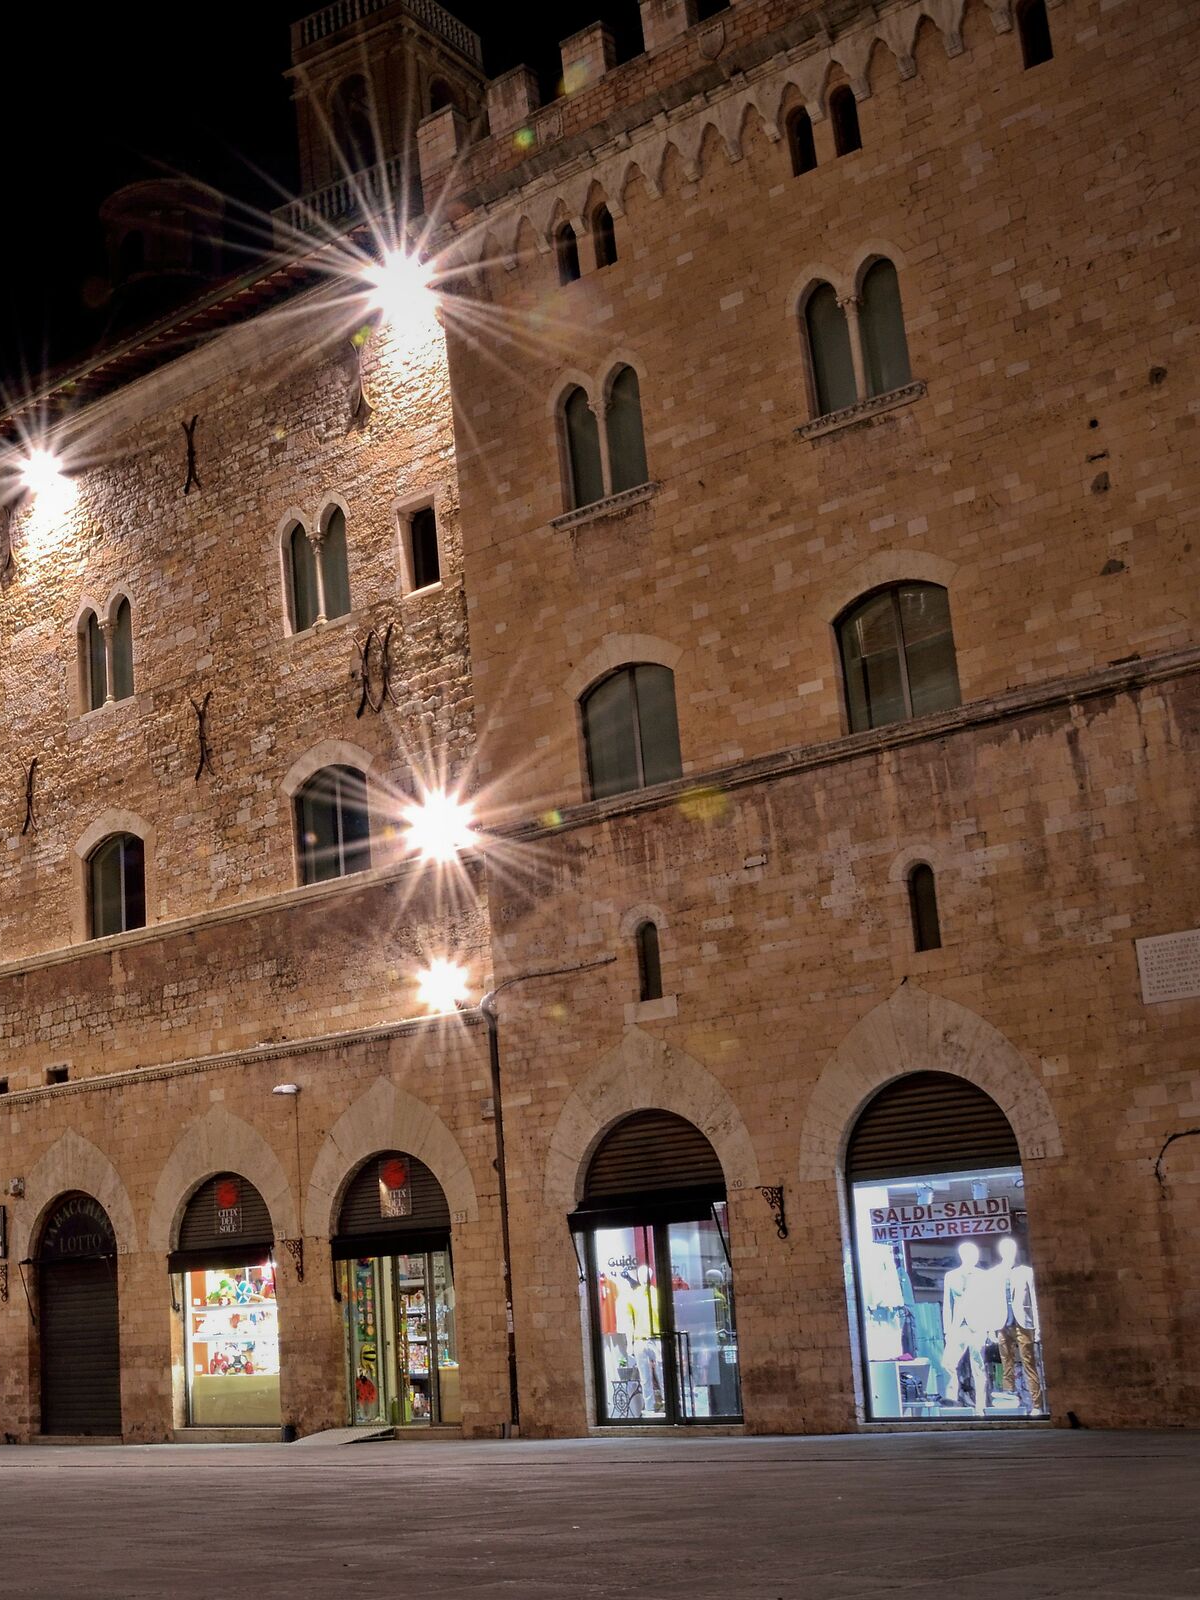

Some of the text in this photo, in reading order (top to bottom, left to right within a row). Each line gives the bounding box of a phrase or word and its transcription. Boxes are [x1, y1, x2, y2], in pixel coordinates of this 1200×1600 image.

[219, 1224, 238, 1234] SOLE
[60, 1233, 102, 1253] LOTTO
[607, 1255, 639, 1268] Guido
